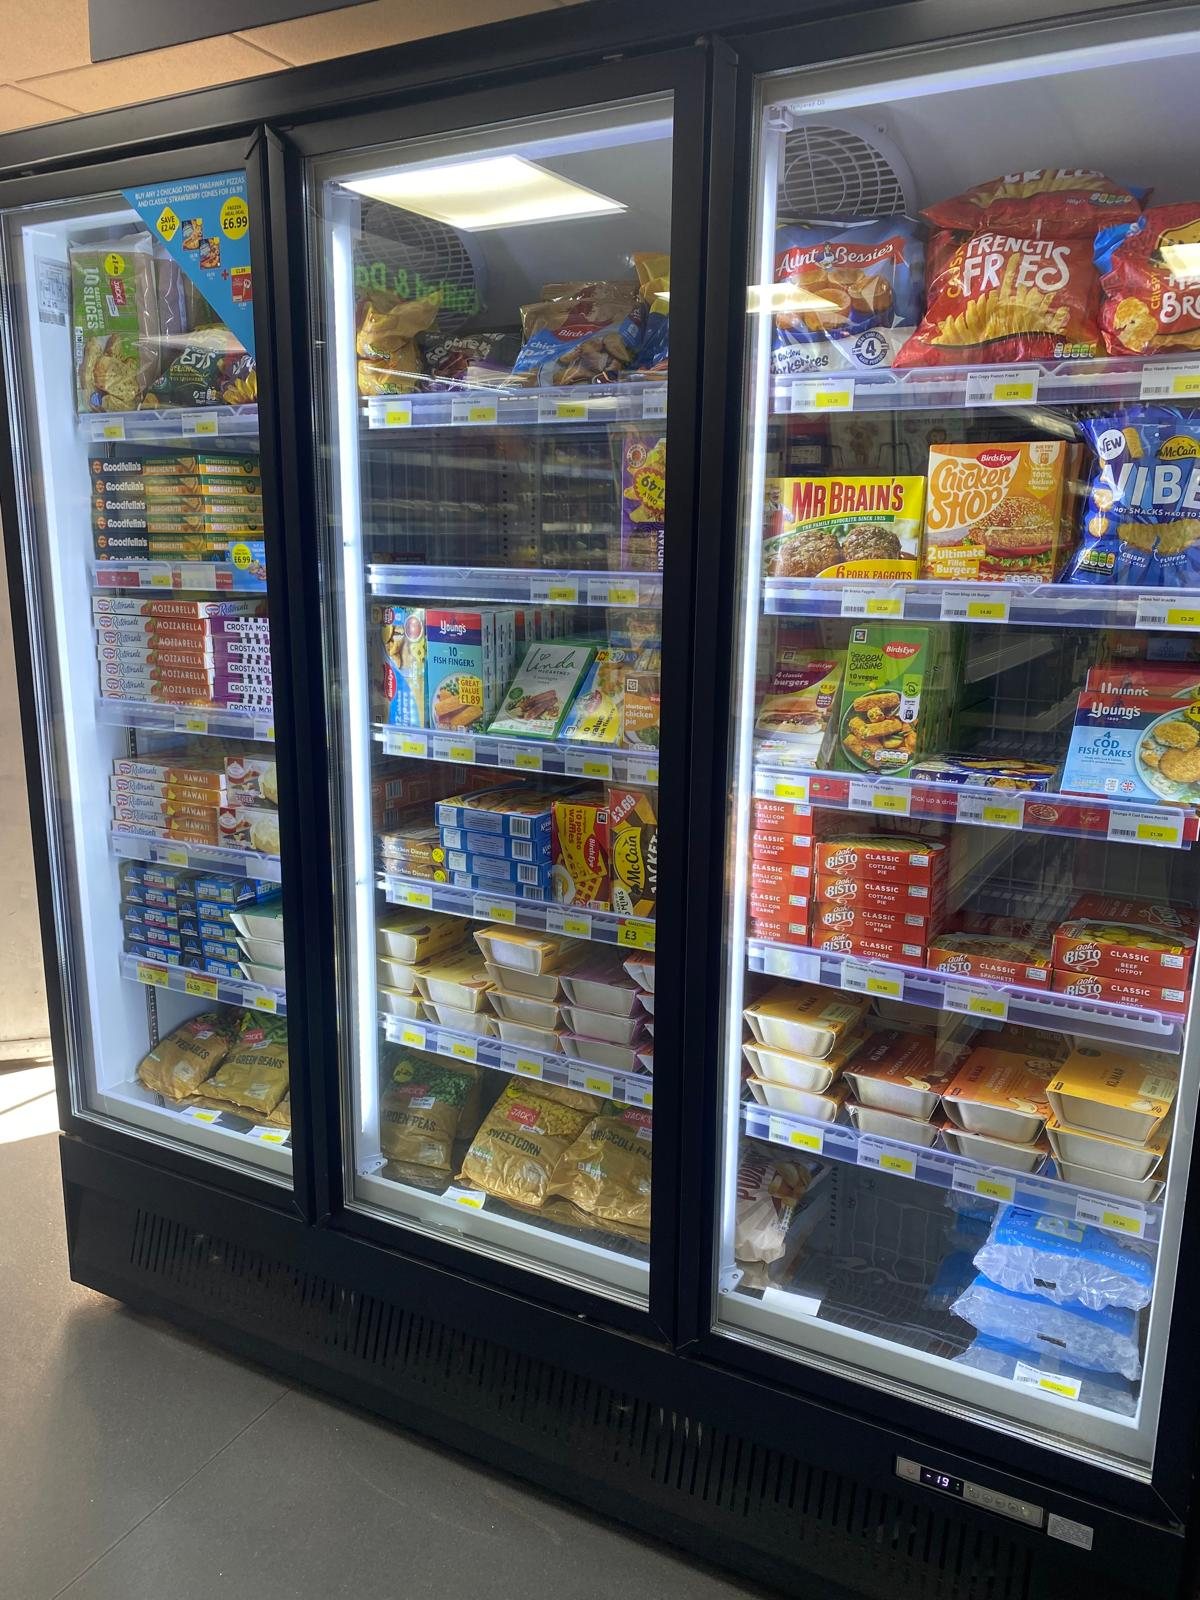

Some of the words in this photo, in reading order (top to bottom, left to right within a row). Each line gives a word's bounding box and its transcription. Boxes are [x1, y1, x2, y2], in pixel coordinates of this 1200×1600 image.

[160, 186, 182, 196] CHICAGO
[184, 184, 198, 194] TOWN
[200, 180, 226, 191] TAKEAWAY
[226, 177, 245, 186] PIZZAS
[169, 194, 201, 204] STRAWBERRY
[202, 190, 218, 199] CONES
[160, 216, 175, 224] SAVE
[223, 216, 248, 230] £6.99
[162, 224, 176, 232] £2.40
[966, 232, 1054, 260] FRENCH
[776, 249, 818, 276] Aunt
[84, 267, 100, 284] 10
[961, 246, 1071, 298] FRIES
[1151, 272, 1161, 309] CRISPY
[84, 286, 98, 329] SLICES
[866, 340, 876, 356] 4
[1162, 446, 1196, 458] McCain
[930, 458, 1012, 500] Chicken
[792, 481, 827, 523] MR
[829, 478, 904, 514] BRAIN'S
[926, 486, 1007, 530] SHOP
[1129, 508, 1164, 516] SNACKS
[1165, 510, 1185, 518] MADE
[831, 517, 858, 526] FAVOURITE
[928, 548, 936, 559] 2
[938, 548, 985, 558] Ultimate
[234, 556, 250, 564] £6.99
[836, 566, 846, 579] 6
[846, 570, 870, 579] PORK
[872, 571, 912, 580] FAGGOTS
[936, 565, 977, 576] Burgers
[152, 602, 196, 614] MOZZARELLA
[156, 620, 202, 632] MOZZARELLA
[226, 623, 253, 632] CROSTA
[440, 620, 467, 636] Young's
[230, 645, 255, 654] CROSTA
[449, 646, 458, 657] 10
[434, 656, 446, 664] FISH
[448, 658, 474, 668] FINGERS
[526, 648, 576, 672] Linda
[230, 664, 256, 672] CROSTA
[858, 674, 879, 682] veggie
[230, 684, 257, 694] CROSTA
[461, 687, 480, 695] VALUE
[460, 694, 480, 704] £1.89
[625, 710, 654, 718] chicken
[1088, 702, 1141, 720] Young's
[1104, 731, 1112, 739] 4
[1094, 738, 1120, 748] COD
[1078, 746, 1100, 756] FISH
[1102, 748, 1132, 758] CAKES
[184, 773, 208, 784] HAWAII
[182, 790, 208, 801] HAWAII
[576, 810, 582, 820] 10
[568, 808, 576, 844] waffles
[624, 835, 640, 885] McCain
[825, 854, 858, 868] BISTO
[864, 854, 900, 863] CLASSIC
[864, 884, 899, 893] CLASSIC
[862, 912, 896, 921] CLASSIC
[625, 930, 637, 940] £3
[821, 940, 852, 952] BISTO
[860, 940, 893, 950] CLASSIC
[863, 950, 890, 958] COTTAGE
[1063, 950, 1102, 964] BISTO
[1110, 950, 1150, 962] CLASSIC
[938, 961, 972, 974] BISTO
[979, 963, 1016, 975] CLASSIC
[1114, 966, 1143, 976] HOTPOT
[980, 972, 1014, 983] SPAGHETTI
[186, 982, 200, 991] £4.50
[1067, 984, 1102, 996] BISTO
[1110, 984, 1150, 996] CLASSIC
[258, 1055, 285, 1069] BEANS
[510, 1106, 536, 1122] JACK'S
[411, 1116, 436, 1132] PEAS
[486, 1128, 542, 1156] SWEETCORN
[1118, 1256, 1145, 1271] CUBES
